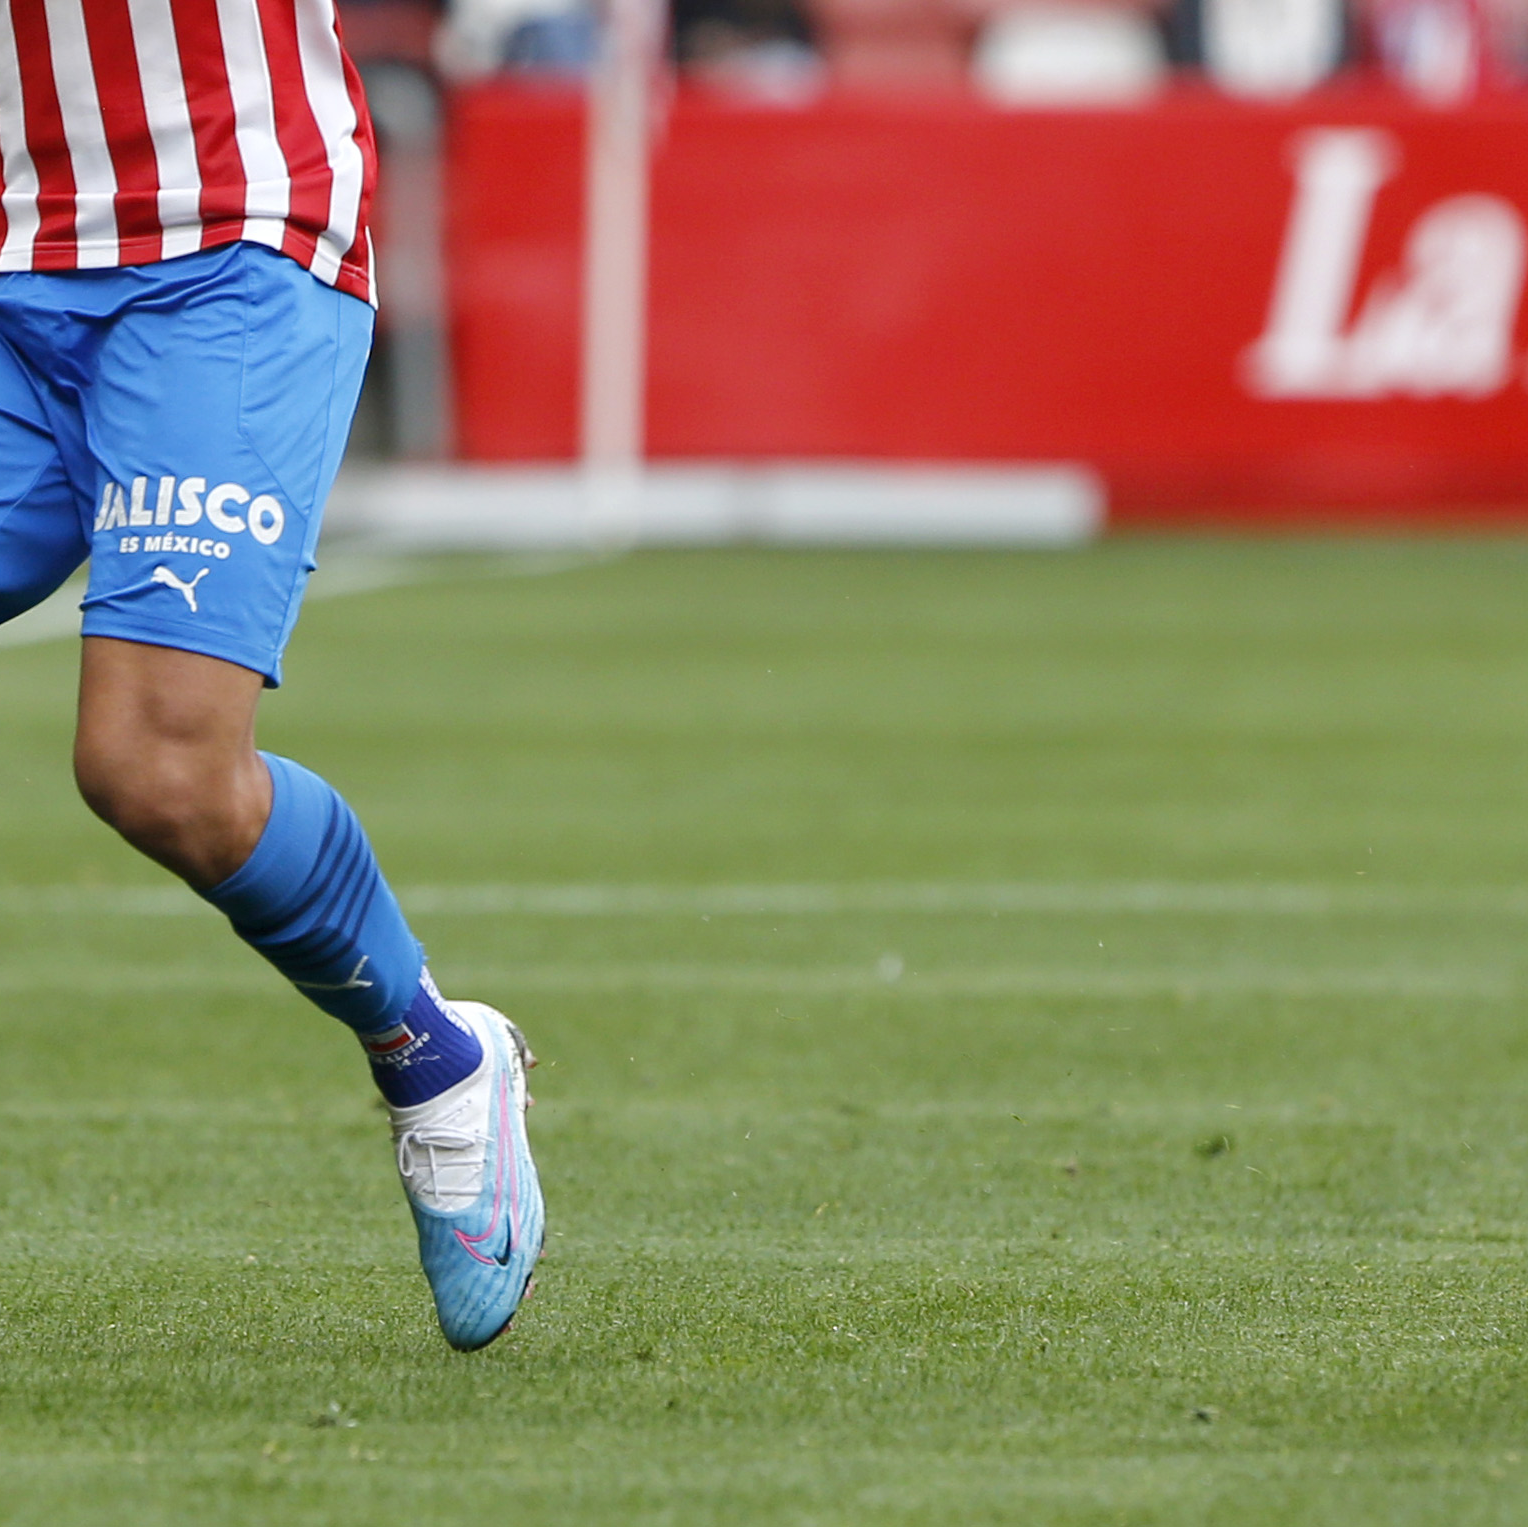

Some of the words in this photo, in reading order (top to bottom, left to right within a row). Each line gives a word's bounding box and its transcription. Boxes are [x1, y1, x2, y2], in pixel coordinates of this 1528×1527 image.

[1241, 128, 1528, 400] La
[93, 476, 285, 545] JALISCO
[119, 536, 140, 553] ES
[144, 531, 231, 560] MÉXICO
